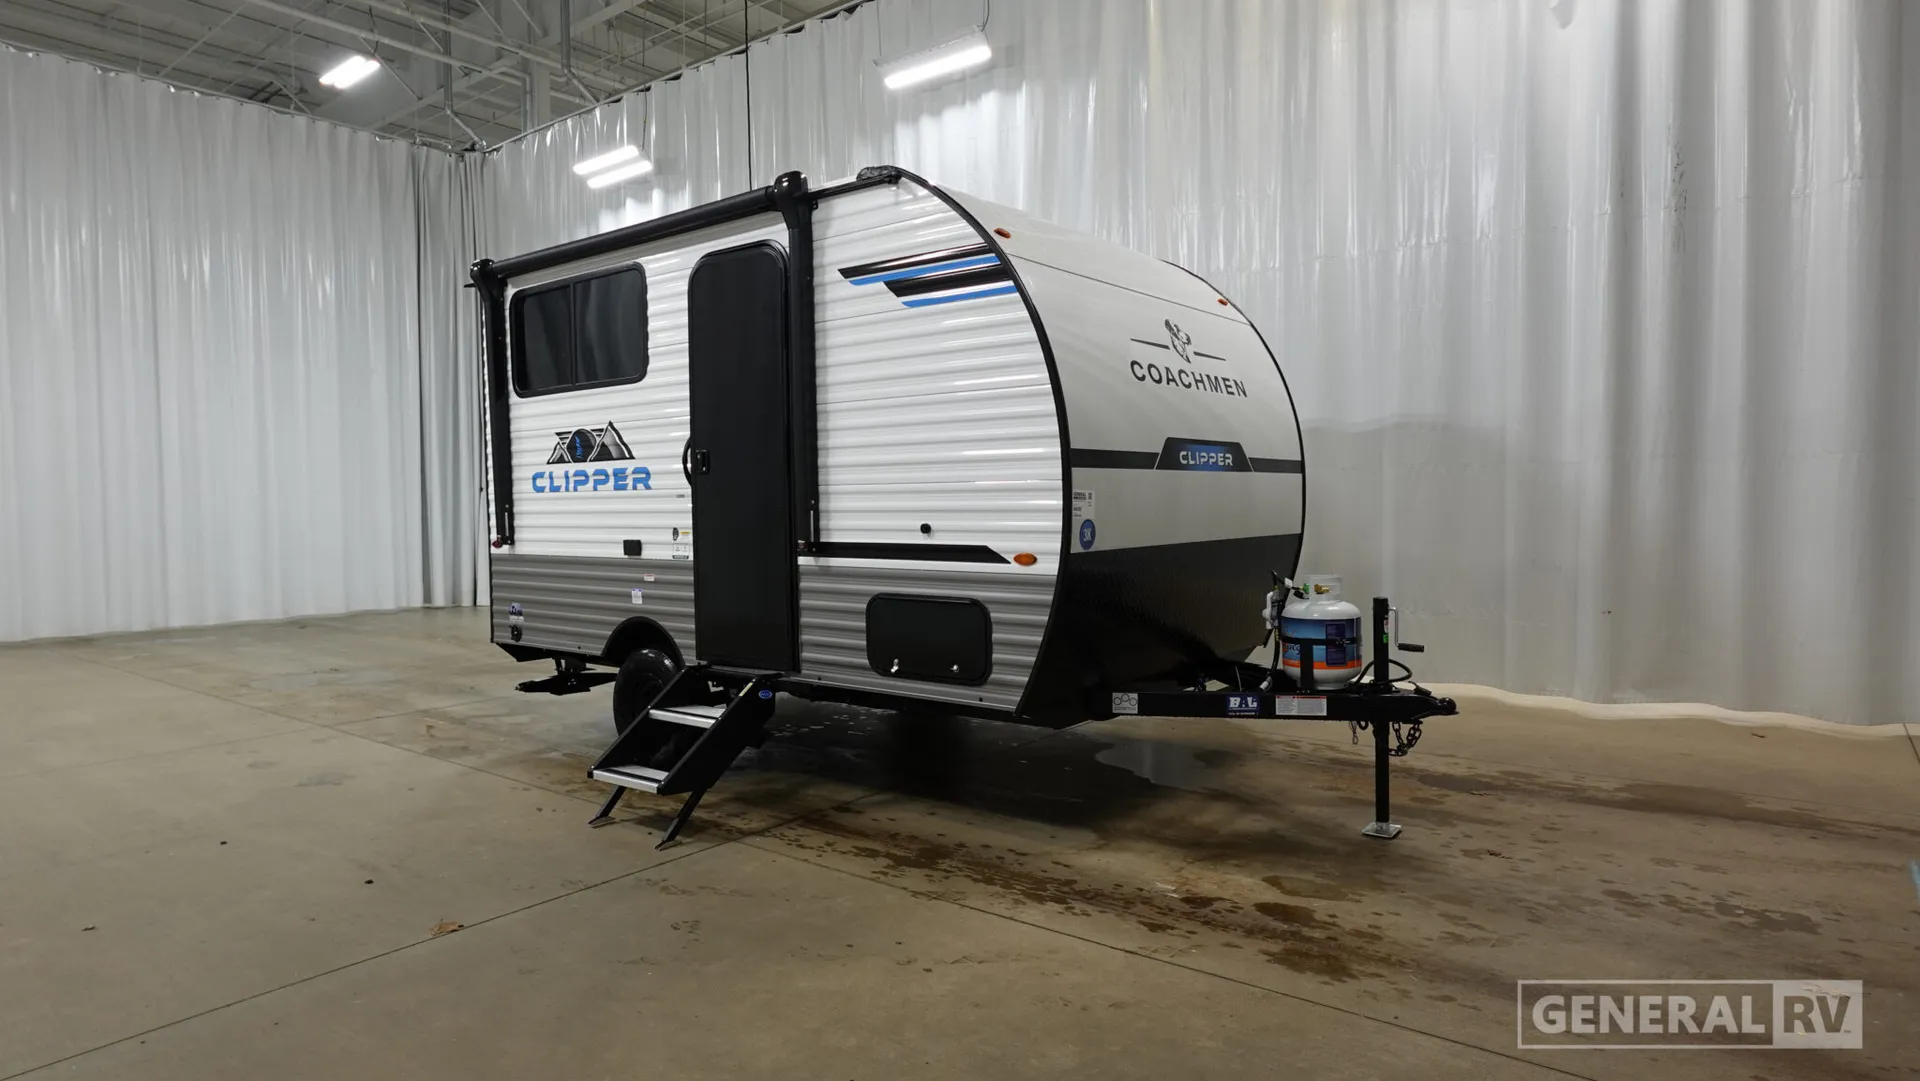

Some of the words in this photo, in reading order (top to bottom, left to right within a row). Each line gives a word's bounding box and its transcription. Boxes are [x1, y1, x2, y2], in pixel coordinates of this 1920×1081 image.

[1130, 360, 1248, 398] COACHMEN
[1179, 451, 1234, 466] CLIPPER
[532, 466, 653, 493] CLIPPER
